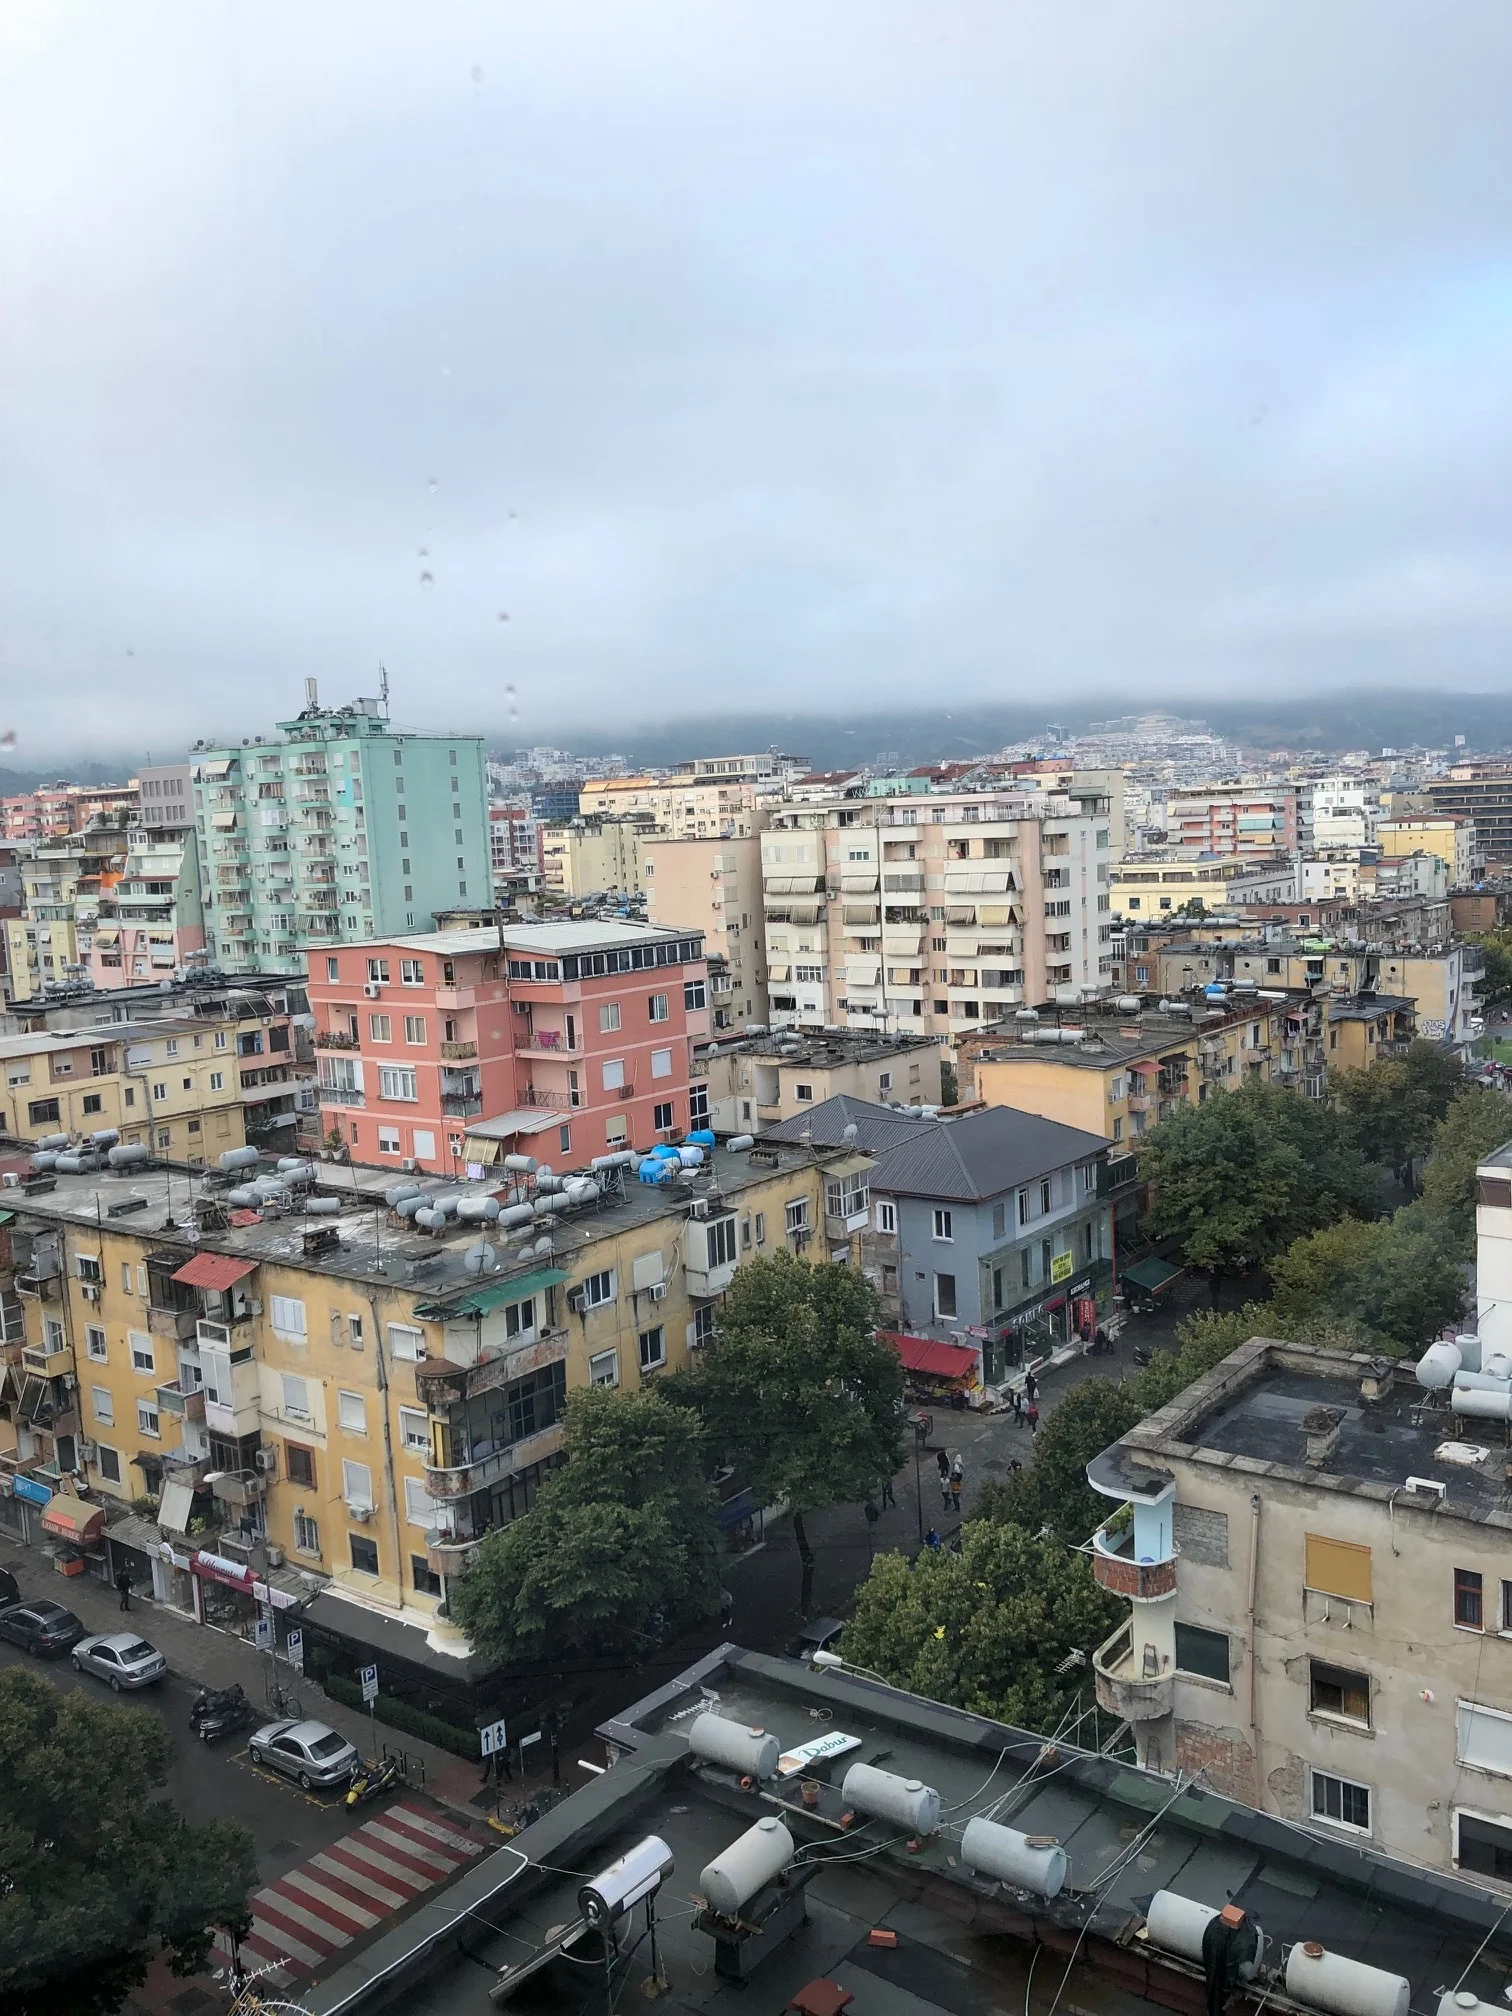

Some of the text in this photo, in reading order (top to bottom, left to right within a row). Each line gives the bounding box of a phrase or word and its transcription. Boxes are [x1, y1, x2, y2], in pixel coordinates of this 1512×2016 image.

[291, 1633, 299, 1646] P
[365, 1668, 374, 1683] P
[799, 1736, 848, 1757] Dabur
